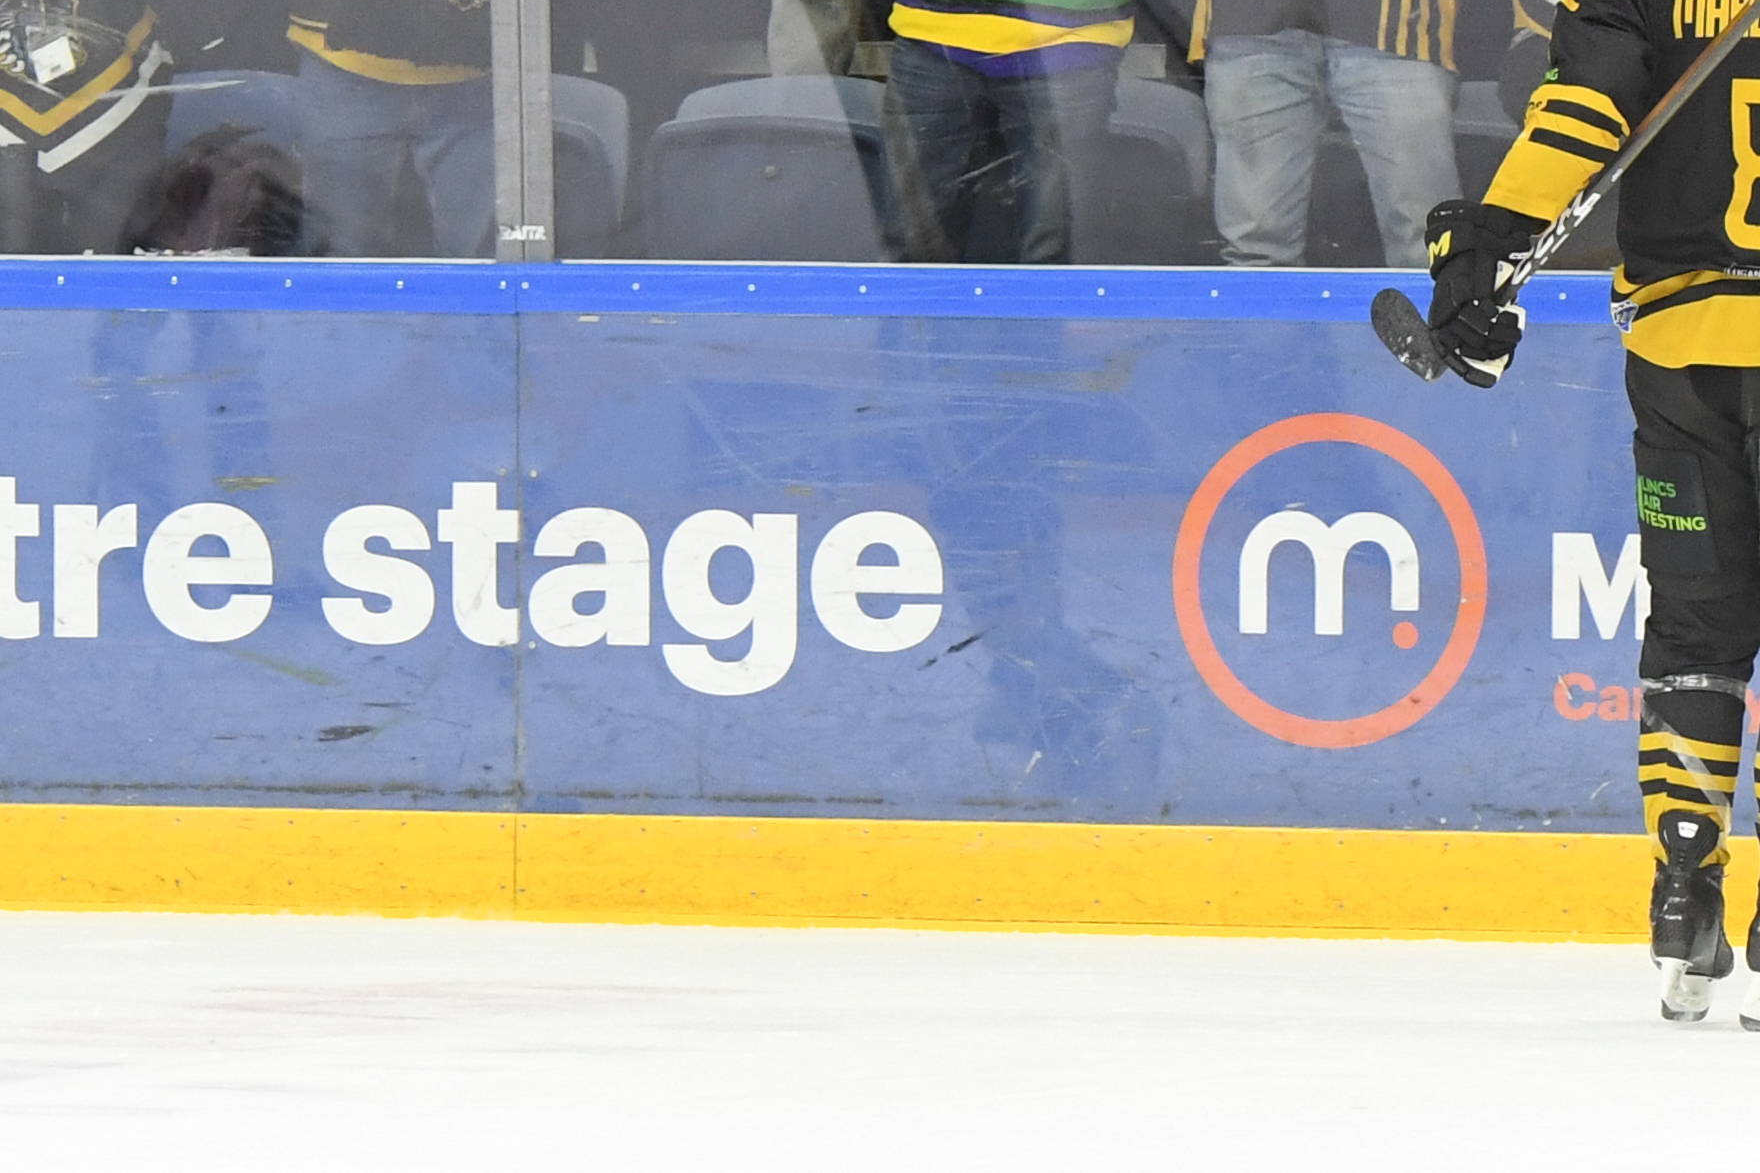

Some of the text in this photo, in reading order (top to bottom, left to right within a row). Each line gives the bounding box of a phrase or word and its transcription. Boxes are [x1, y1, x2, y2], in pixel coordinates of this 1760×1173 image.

[1642, 478, 1677, 498] LINCS
[1643, 495, 1662, 512] AIR
[1643, 510, 1708, 532] TESTING
[321, 481, 945, 697] stage
[1553, 672, 1642, 722] Ca
